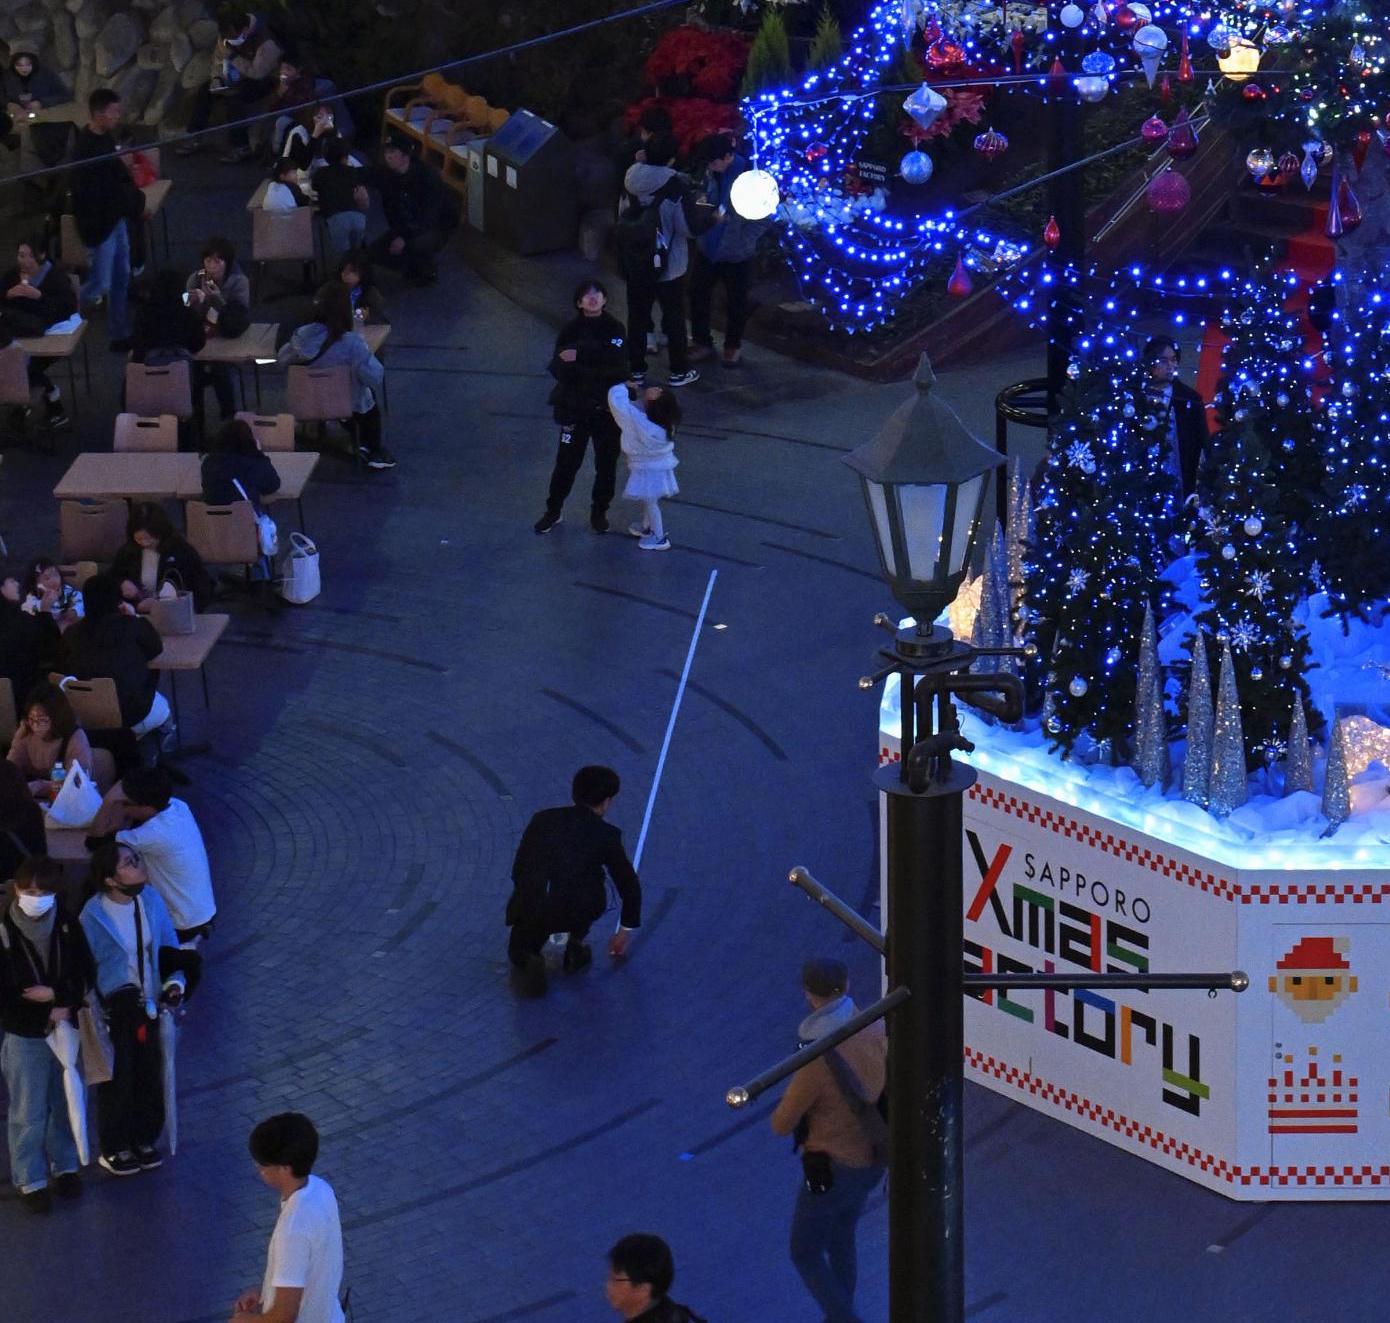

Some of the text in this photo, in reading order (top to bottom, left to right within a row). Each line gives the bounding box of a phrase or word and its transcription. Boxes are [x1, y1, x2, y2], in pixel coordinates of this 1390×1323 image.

[965, 830, 1149, 993] Xmas
[1024, 853, 1151, 924] SAPPORO
[963, 938, 1210, 1117] actory
